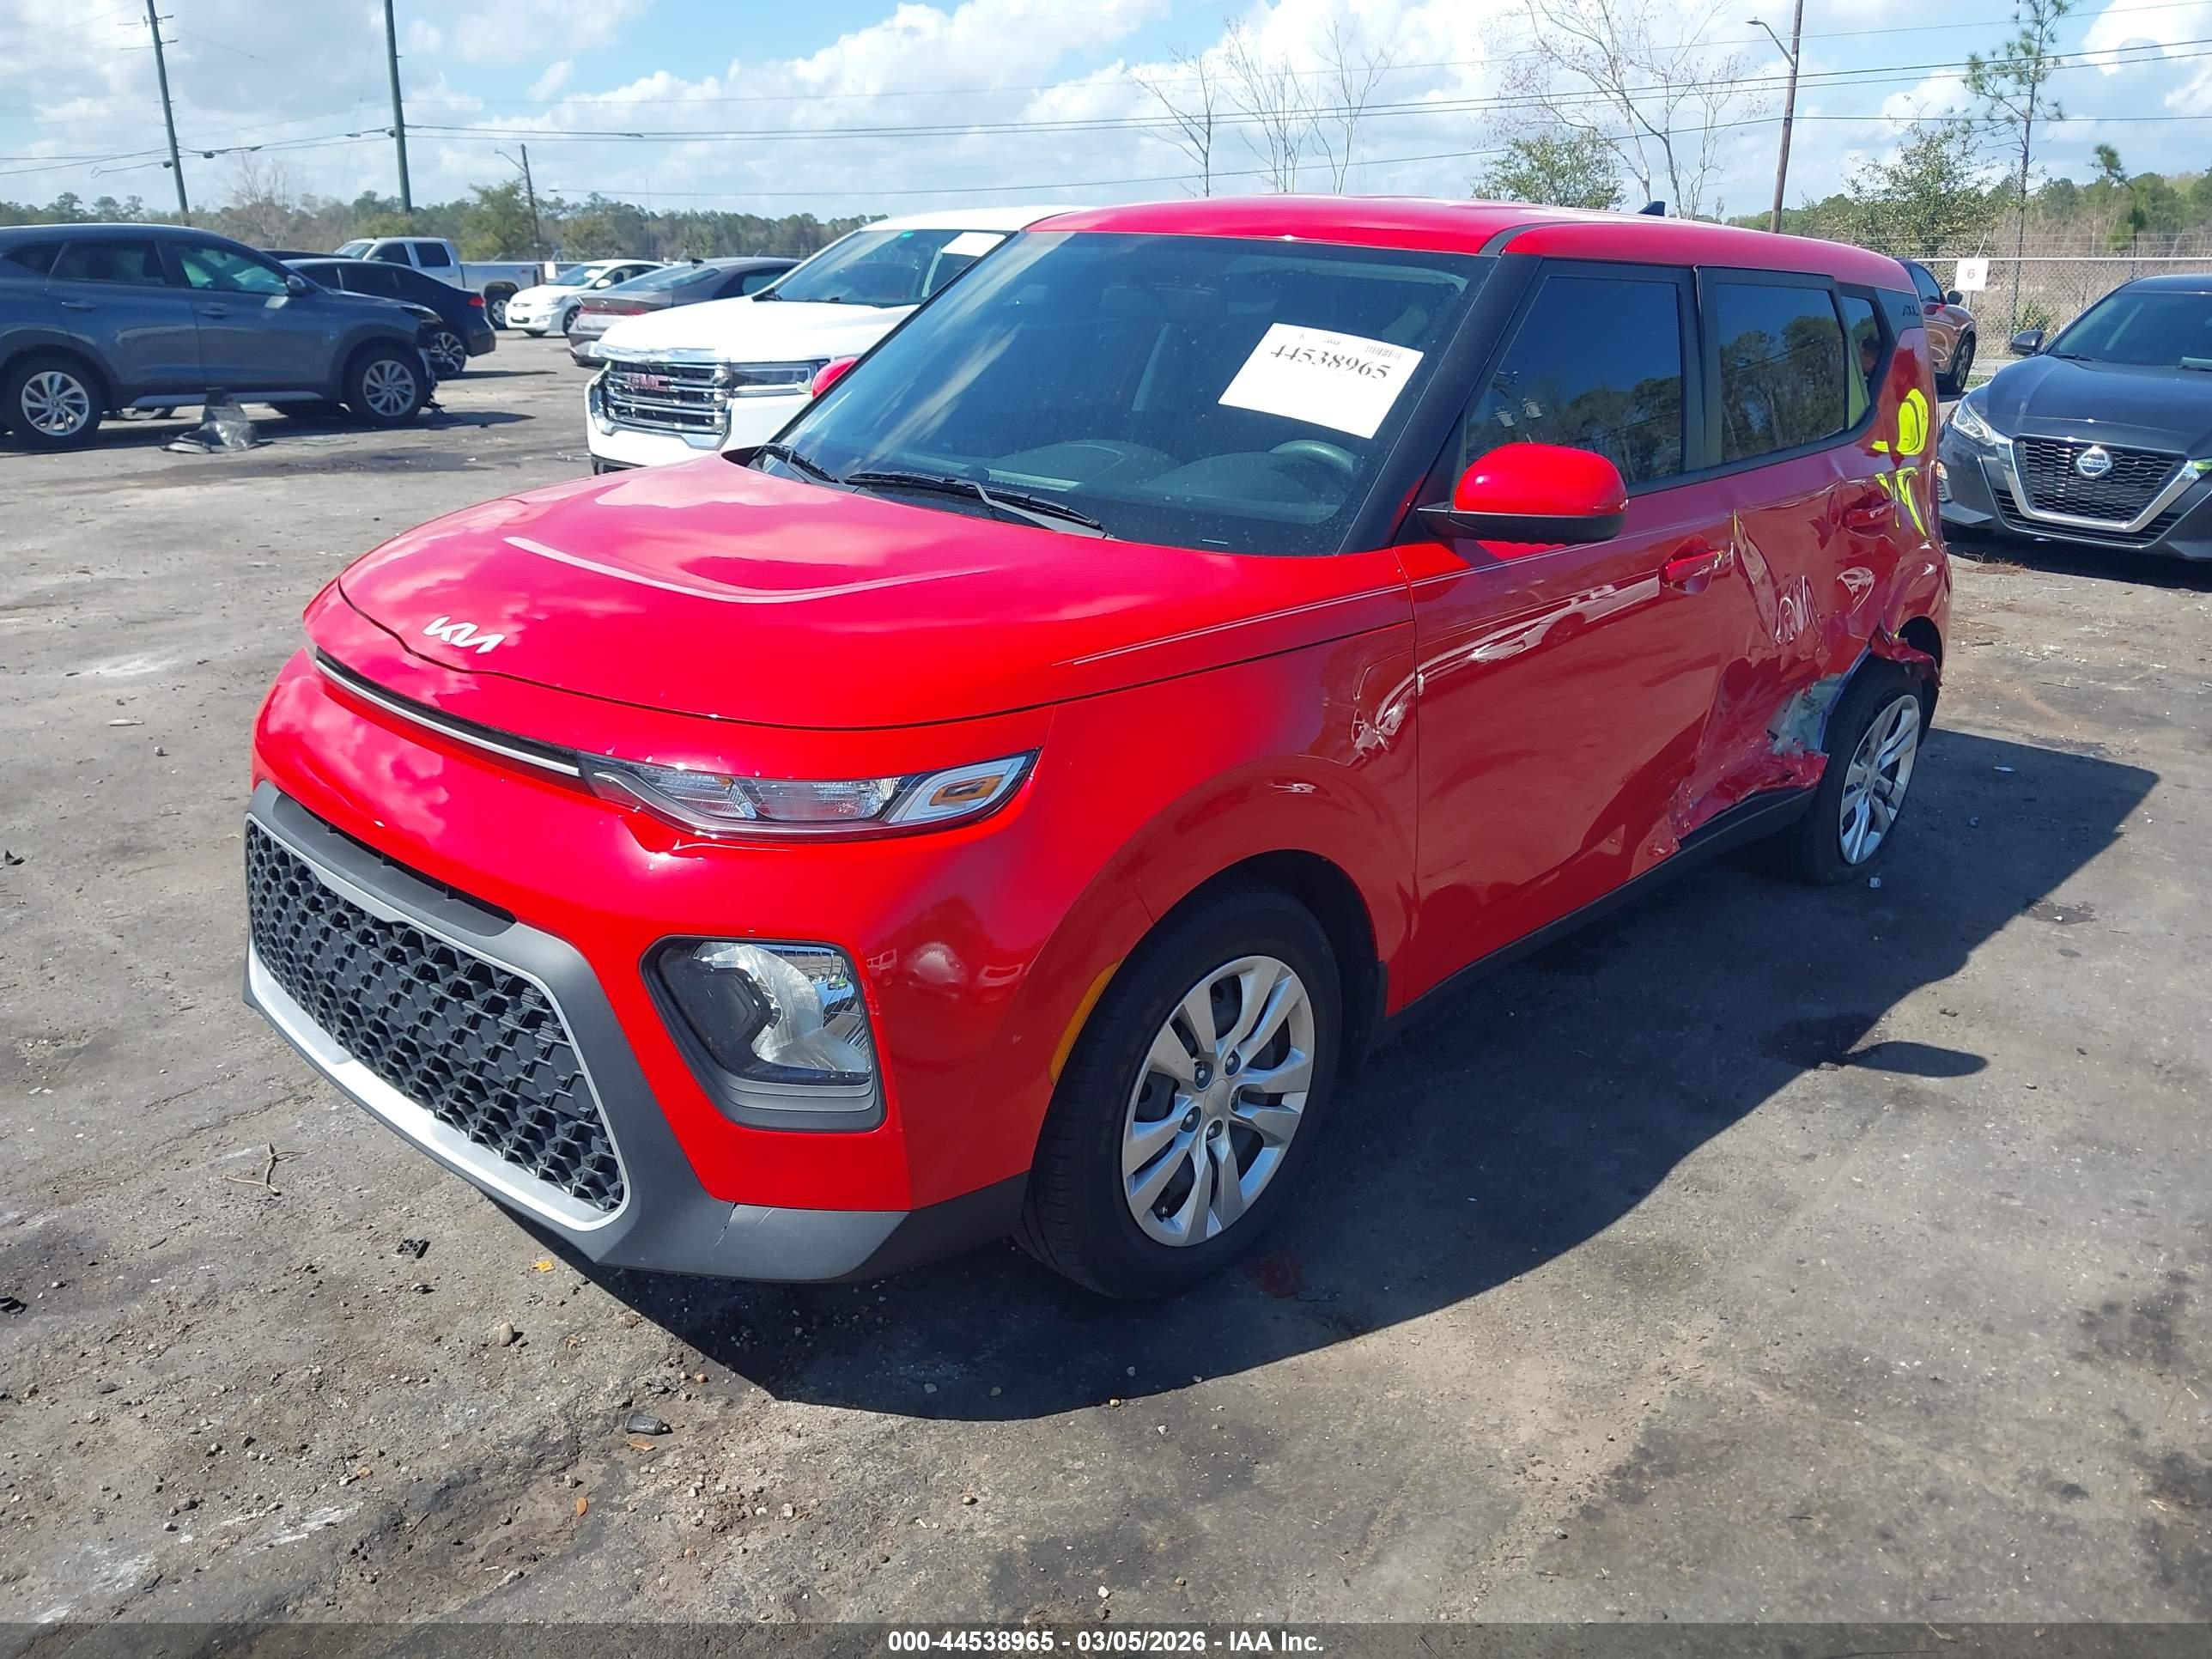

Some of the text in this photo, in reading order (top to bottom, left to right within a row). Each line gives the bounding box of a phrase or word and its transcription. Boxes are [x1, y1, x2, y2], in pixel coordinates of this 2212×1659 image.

[1966, 268, 1976, 279] 6
[1270, 343, 1391, 380] 44538965
[627, 372, 670, 392] GMC
[2080, 459, 2109, 467] NISSAN
